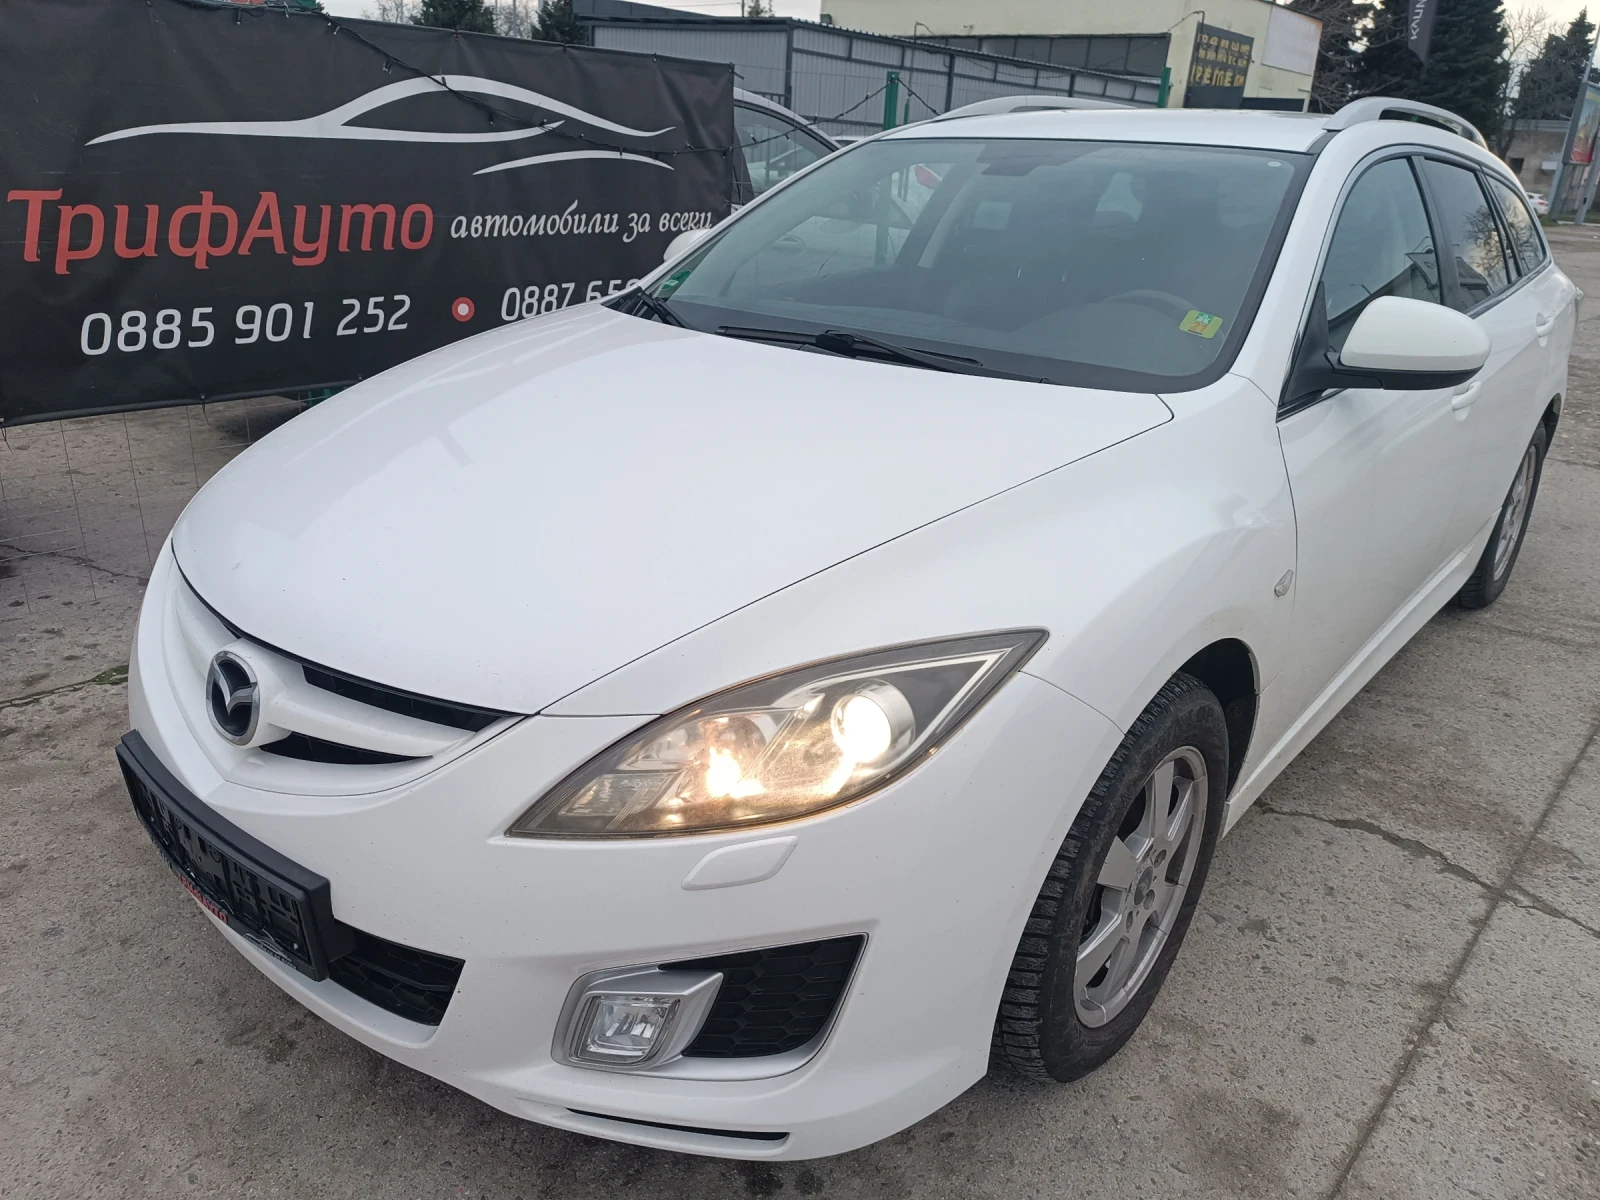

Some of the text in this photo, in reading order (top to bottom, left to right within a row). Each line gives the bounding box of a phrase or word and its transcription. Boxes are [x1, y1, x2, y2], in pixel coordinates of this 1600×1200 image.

[7, 188, 434, 275] ТрифАуто
[450, 200, 713, 243] автомобили за всеки
[80, 294, 412, 356] 0885 901 252
[501, 282, 575, 321] 0887
